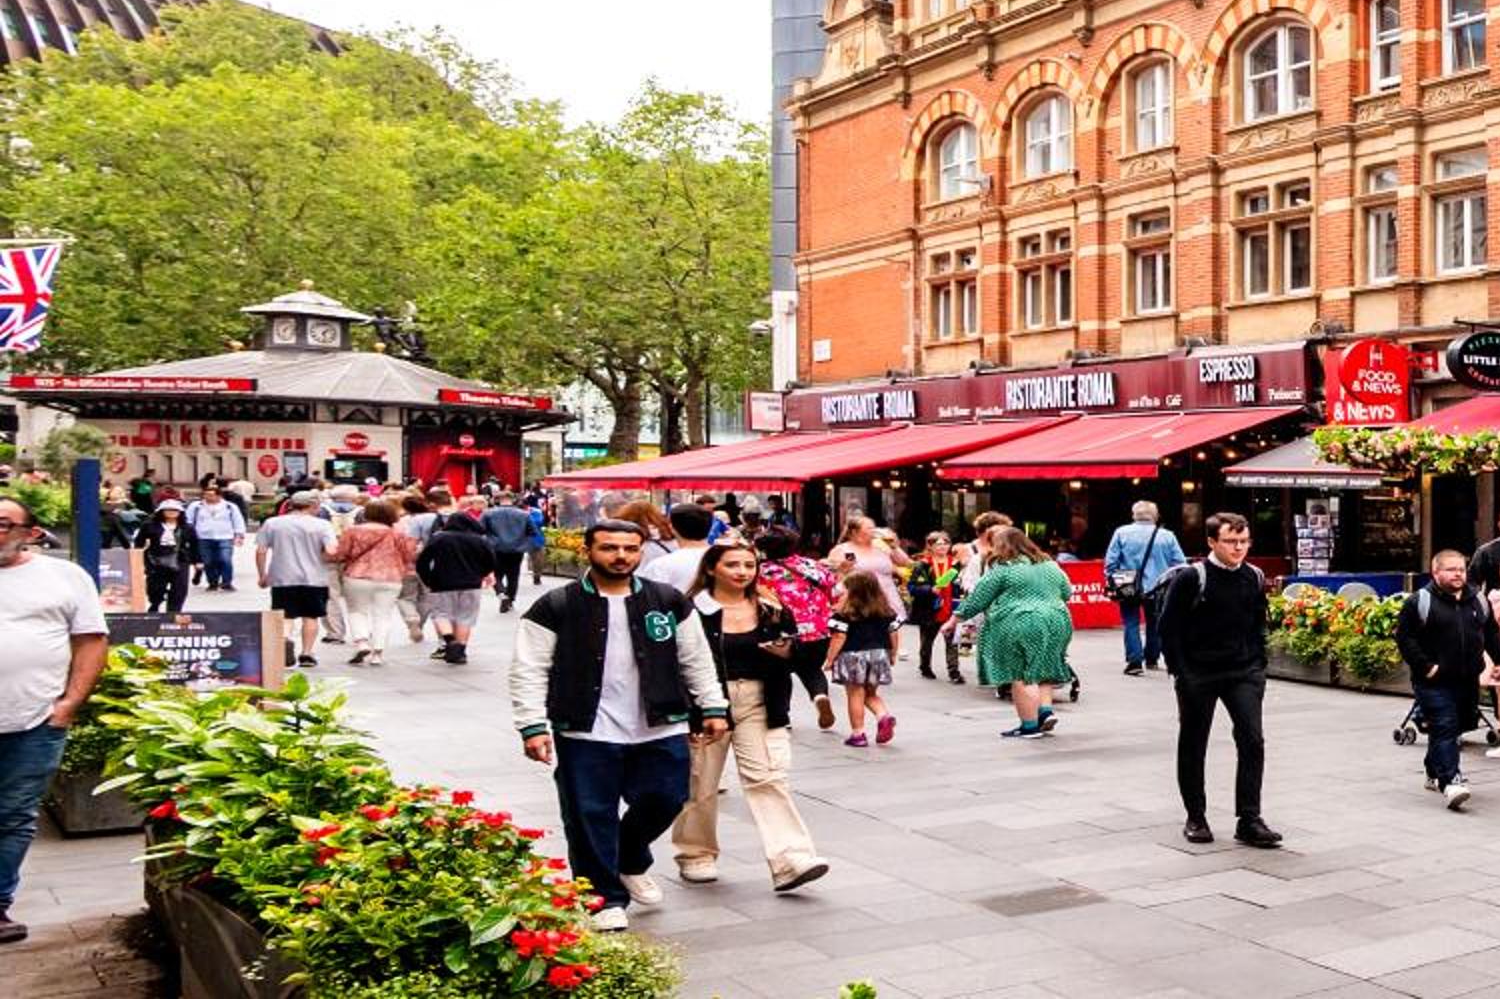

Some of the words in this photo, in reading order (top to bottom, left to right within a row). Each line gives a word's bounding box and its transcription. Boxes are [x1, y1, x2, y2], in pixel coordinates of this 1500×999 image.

[1200, 355, 1255, 383] ESPRESSO
[1463, 355, 1497, 366] LITTLE
[1357, 369, 1396, 383] FOOD
[1005, 375, 1075, 410] RISTORANTE
[1078, 372, 1115, 406] ROMA
[1234, 384, 1255, 403] BAR
[1352, 379, 1361, 392] &
[1363, 381, 1402, 395] NEWS
[821, 393, 880, 423] RISTORANTE
[1333, 402, 1344, 420] &
[1347, 402, 1395, 420] NEWS
[164, 424, 230, 447] tkts
[133, 635, 232, 649] EVENING
